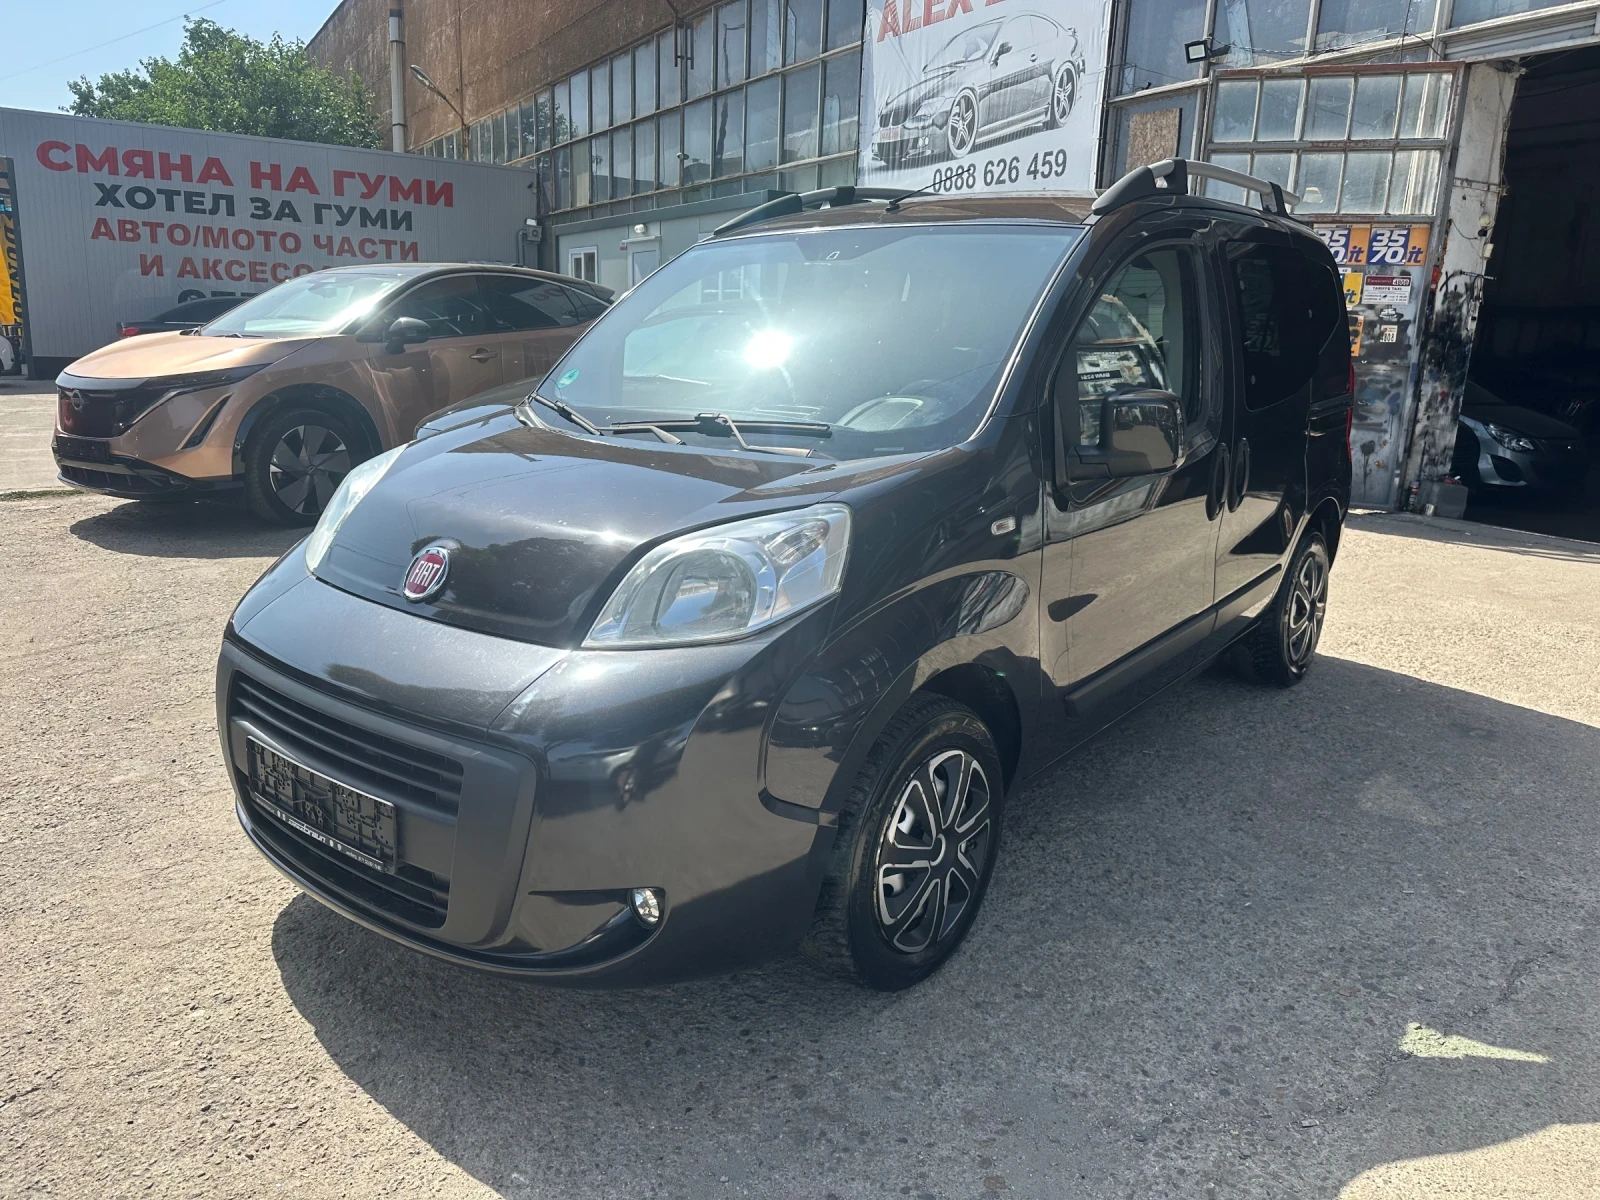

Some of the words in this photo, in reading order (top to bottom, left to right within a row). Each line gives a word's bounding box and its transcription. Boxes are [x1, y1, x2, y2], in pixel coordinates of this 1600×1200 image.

[36, 140, 234, 187] СМЯНА
[249, 161, 320, 195] НА
[333, 169, 454, 208] ГУМИ
[933, 163, 976, 193] 0888
[983, 156, 1020, 187] 626
[1026, 148, 1067, 180] 459
[93, 182, 236, 217] ХОТЕЛ
[249, 197, 302, 223] ЗА
[314, 202, 413, 232] ГУМИ
[90, 217, 302, 254] АВТО/МОТО
[313, 234, 419, 262] ЧАСТИ
[1372, 229, 1408, 247] 35
[139, 253, 164, 277] И
[176, 256, 332, 284] АКСЕСО
[410, 560, 441, 587] FIAT
